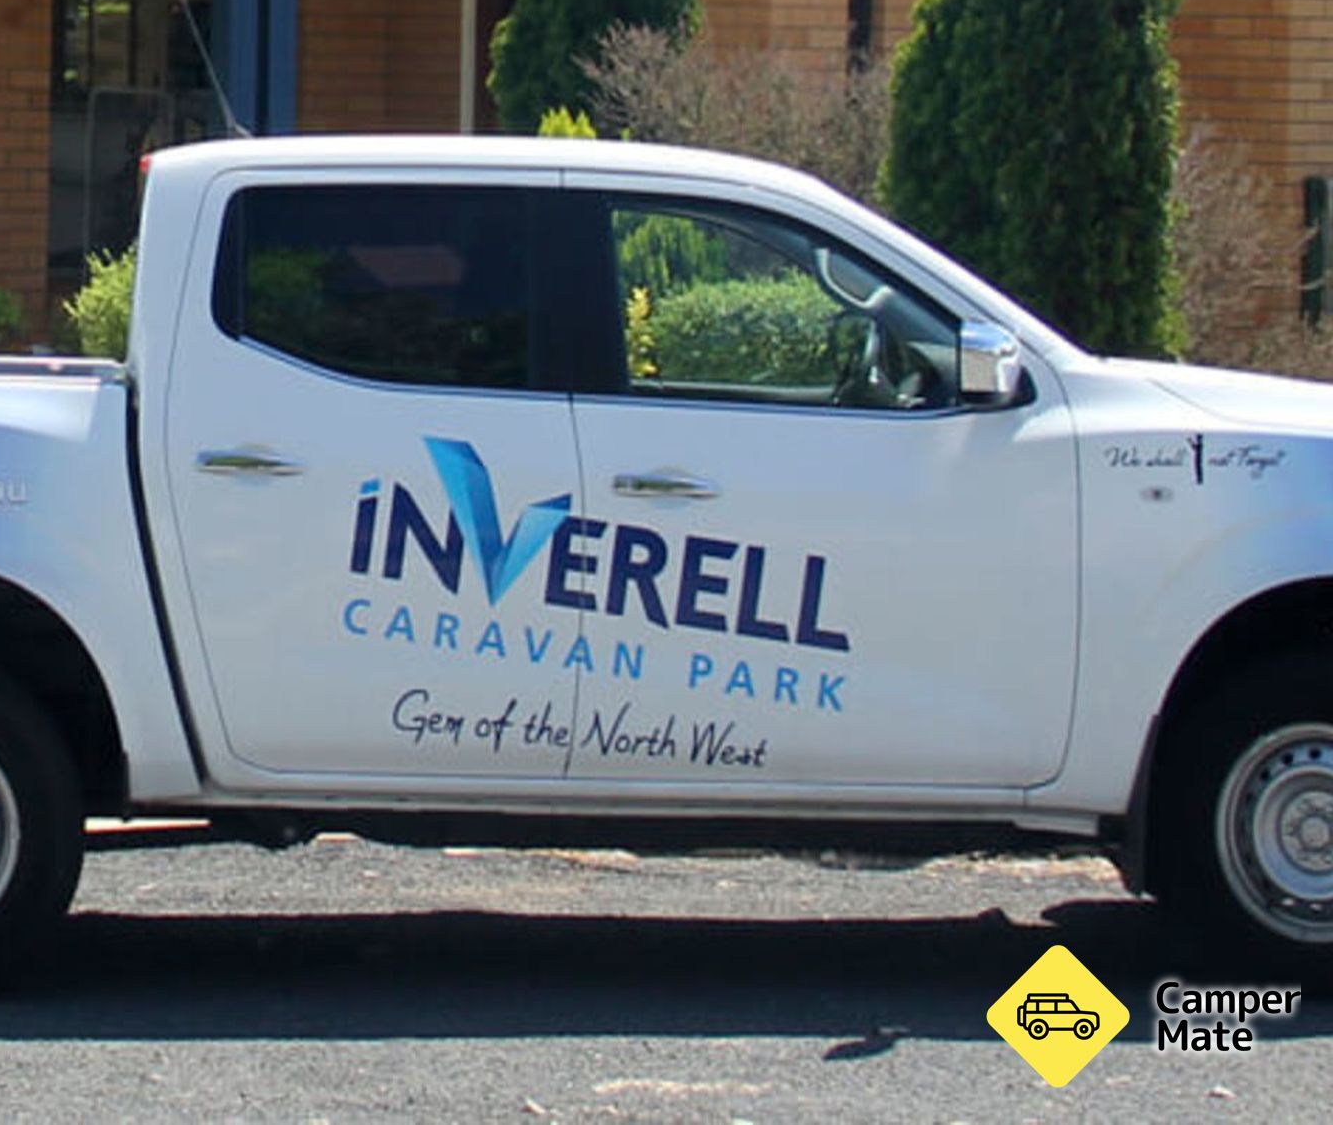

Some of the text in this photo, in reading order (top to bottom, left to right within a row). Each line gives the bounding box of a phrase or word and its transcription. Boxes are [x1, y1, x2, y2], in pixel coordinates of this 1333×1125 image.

[342, 598, 846, 712] CARAVAN PARK
[392, 689, 769, 768] Gem of the North West
